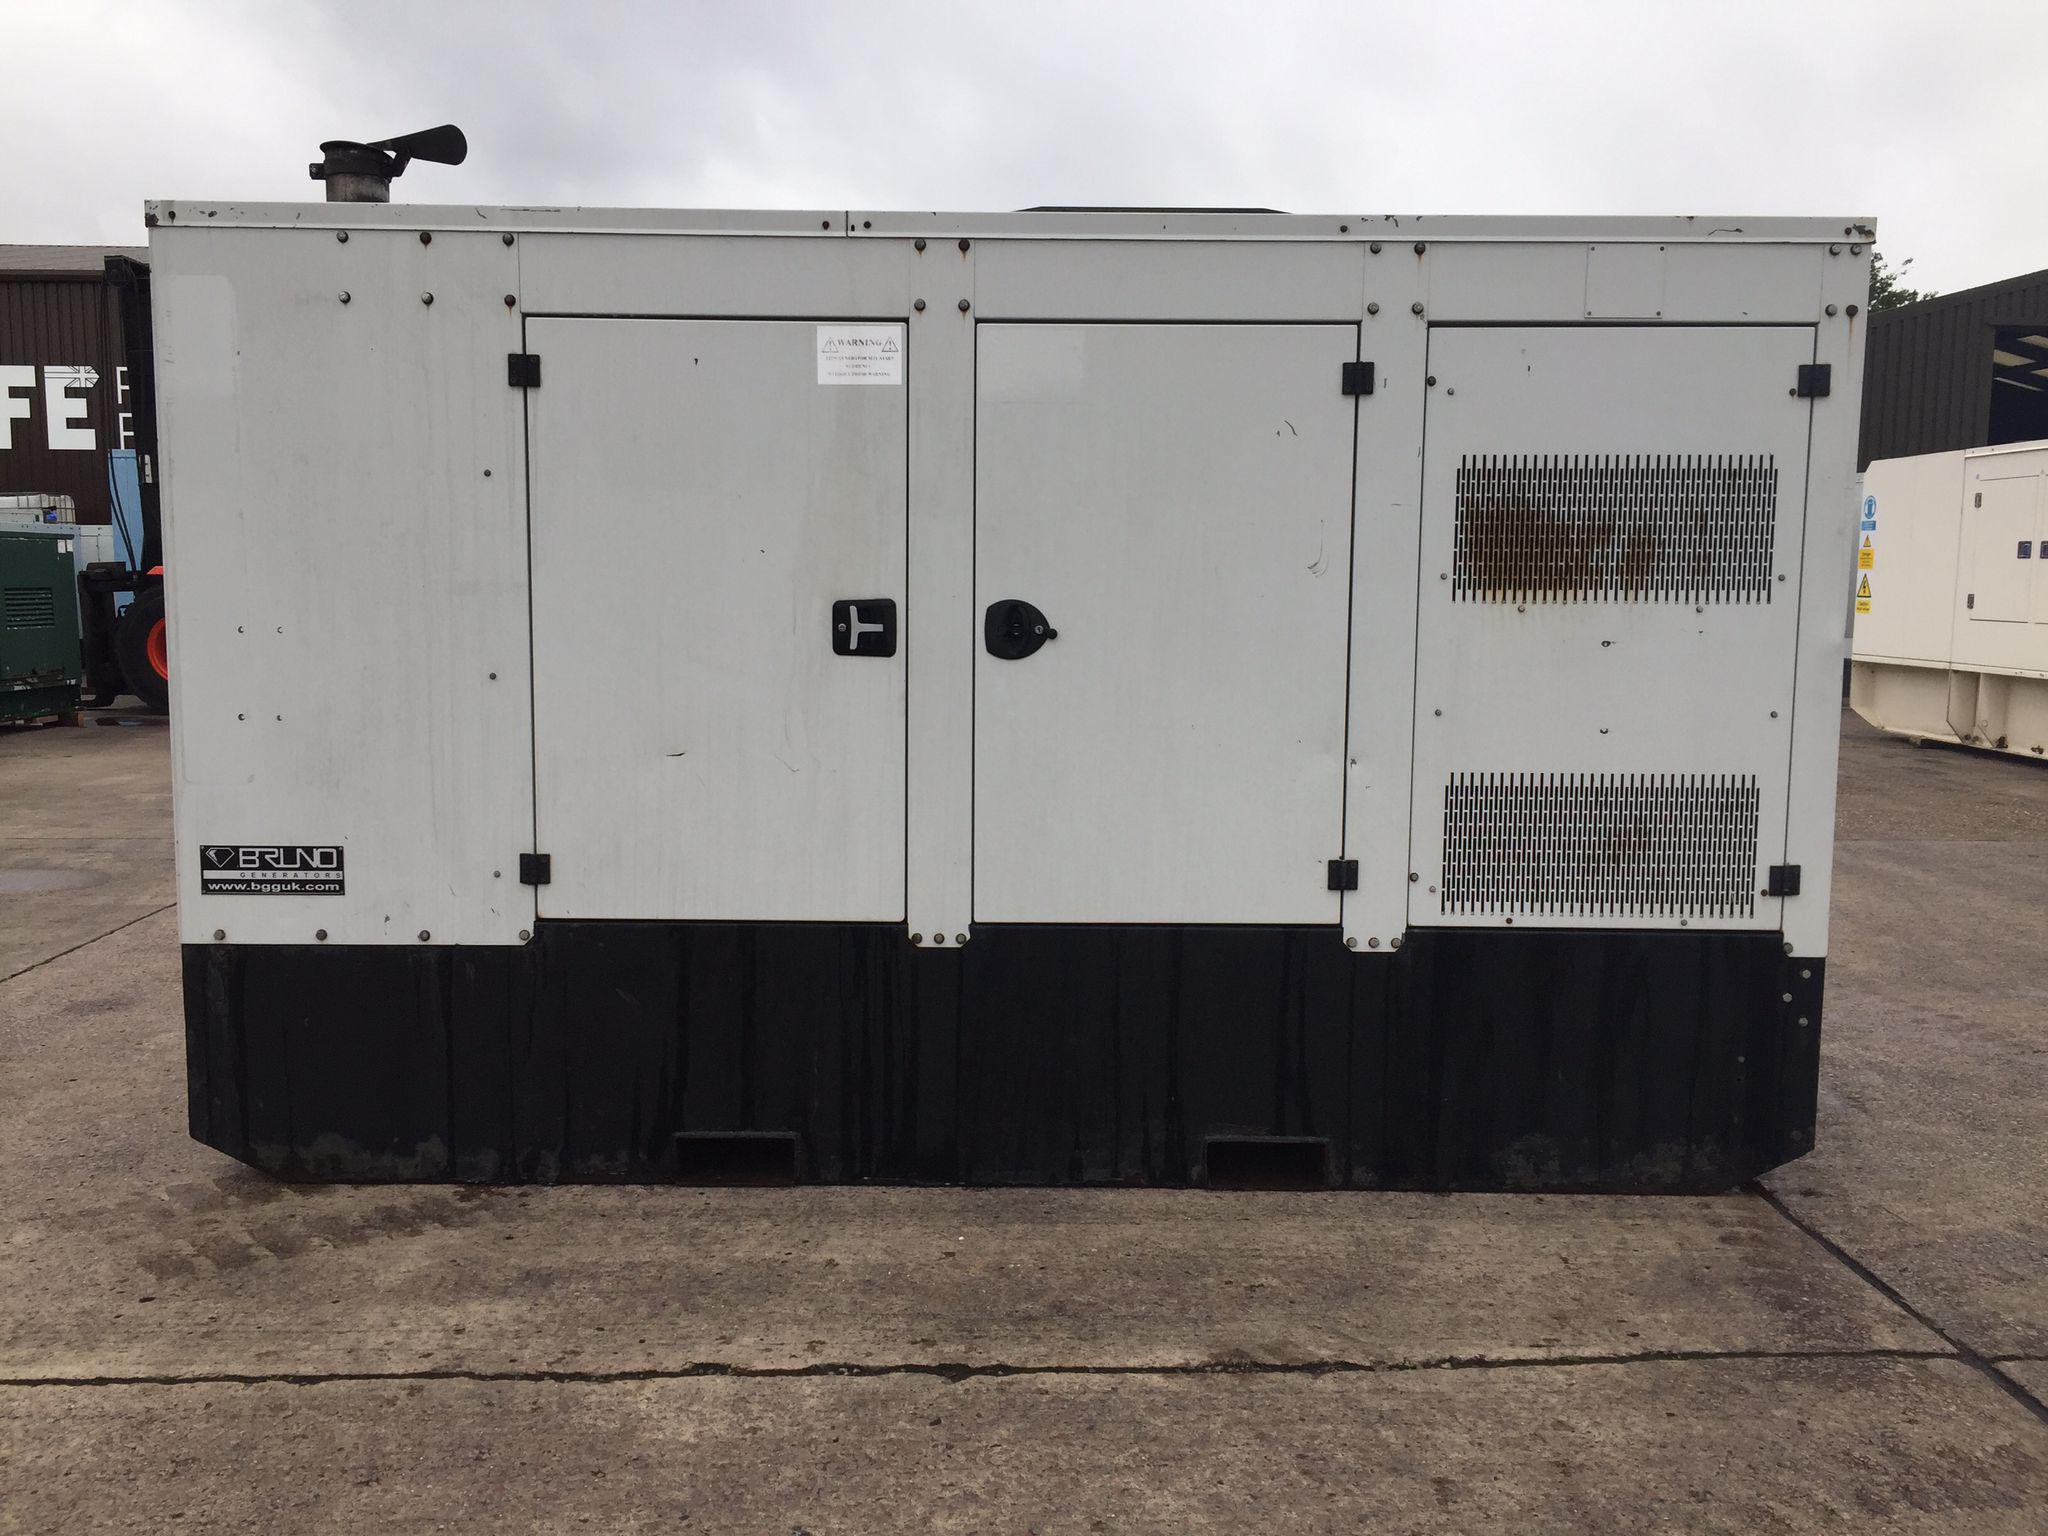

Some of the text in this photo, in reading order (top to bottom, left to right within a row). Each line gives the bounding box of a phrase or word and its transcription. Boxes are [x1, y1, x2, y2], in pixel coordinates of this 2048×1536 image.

[837, 338, 882, 346] WARNING
[238, 847, 338, 868] BRUNO
[207, 882, 340, 893] www.bgguk.com
